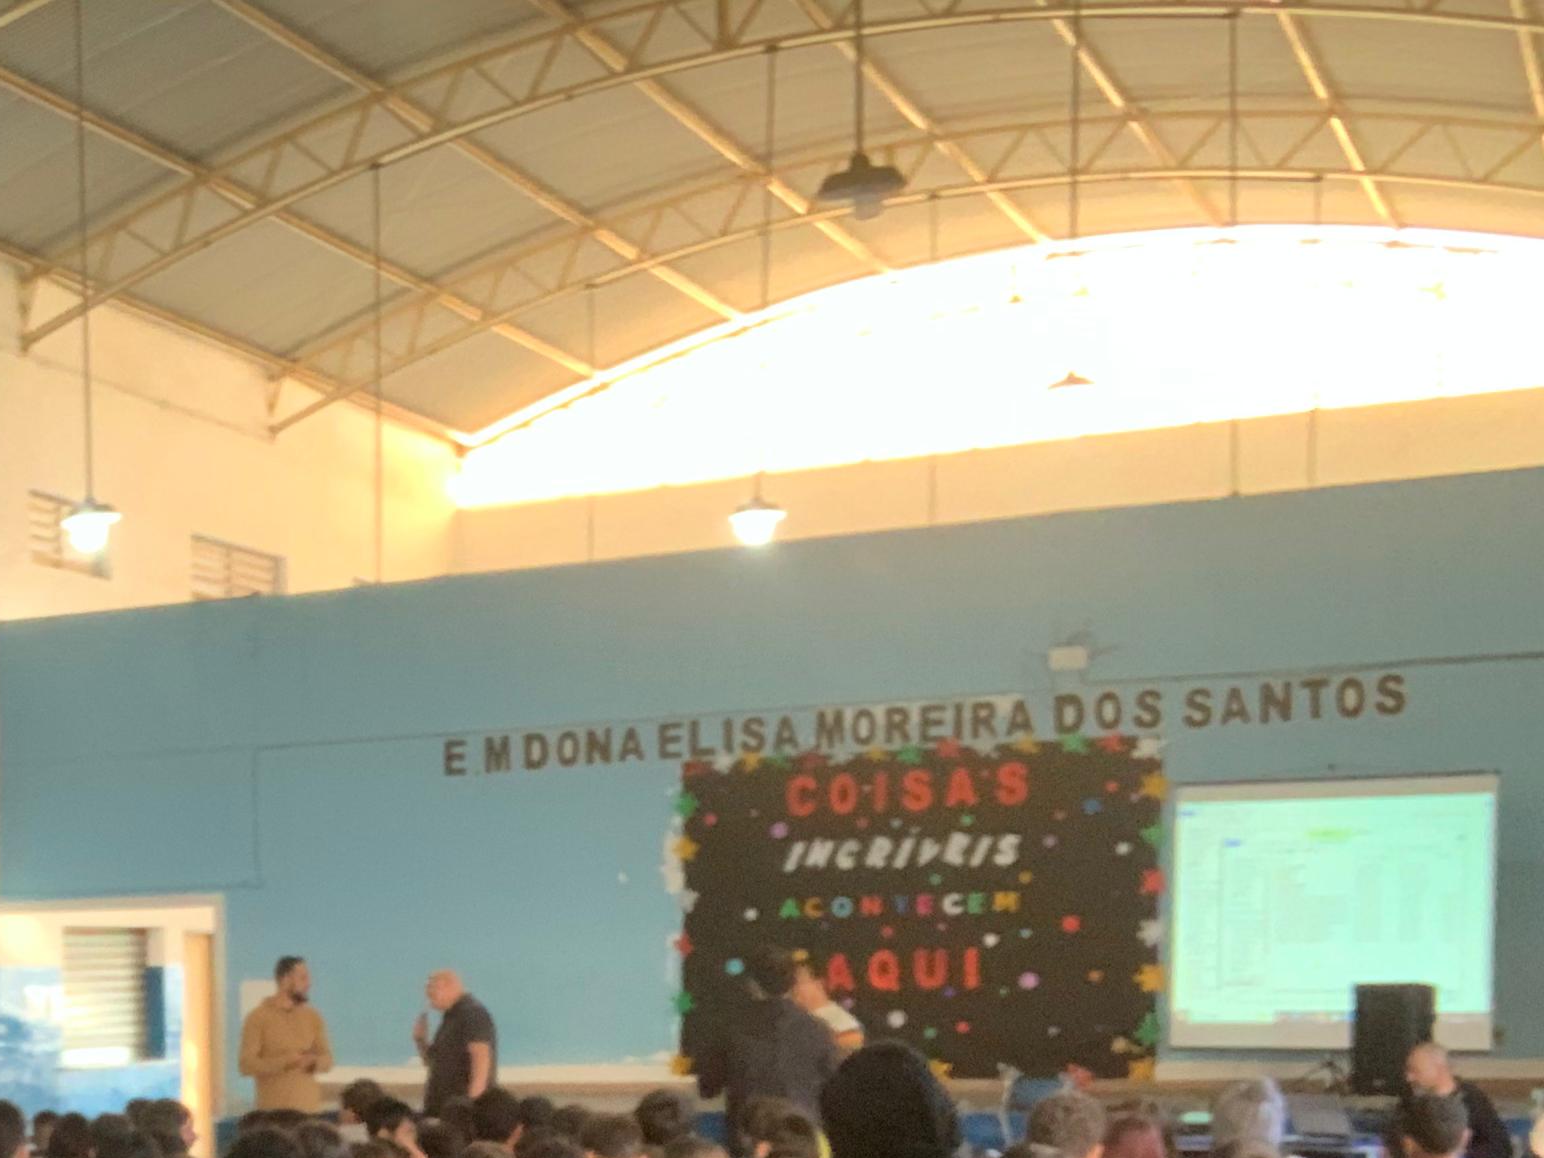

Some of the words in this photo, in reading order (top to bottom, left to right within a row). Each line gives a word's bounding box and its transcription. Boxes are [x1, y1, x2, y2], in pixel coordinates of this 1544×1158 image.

[523, 726, 644, 769] DONA
[658, 714, 799, 760] ELISA
[816, 699, 1035, 749] MOREIRA
[1053, 689, 1162, 734] DOS
[1182, 674, 1405, 728] SANTOS
[785, 761, 1029, 817] COISAS
[778, 891, 1020, 919] ACONTECEM
[826, 946, 981, 992] AQUI
